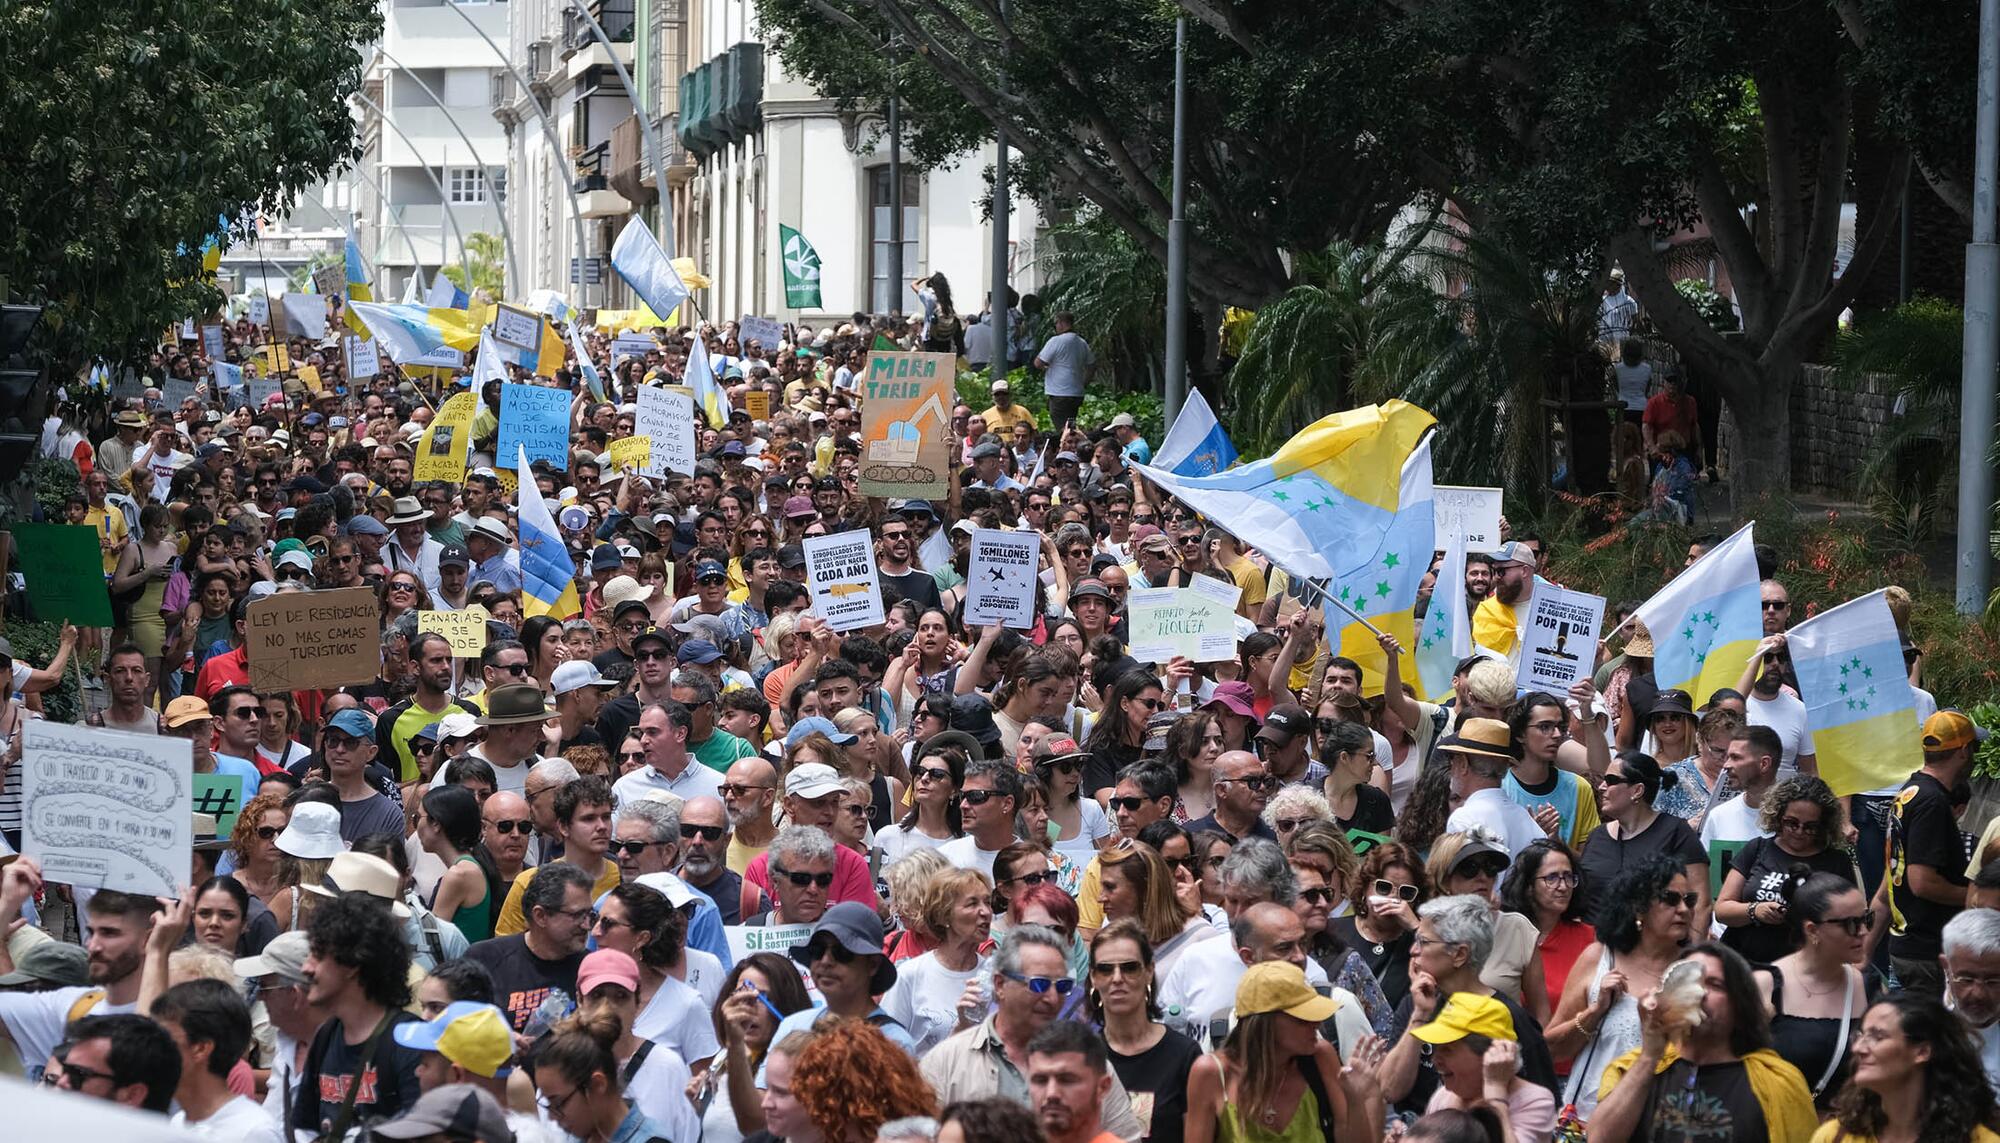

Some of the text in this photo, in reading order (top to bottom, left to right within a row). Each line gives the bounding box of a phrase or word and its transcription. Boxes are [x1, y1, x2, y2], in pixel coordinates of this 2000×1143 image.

[870, 356, 936, 380] MORA
[509, 388, 566, 402] NUEVO
[508, 401, 566, 412] MODELO
[521, 413, 544, 422] DE
[504, 423, 566, 434] TURISMO
[650, 428, 662, 437] NO
[650, 440, 683, 453] ENDE
[418, 460, 458, 469] SE ACABA
[432, 470, 458, 480] JUEGO
[812, 546, 852, 559] ATROPELLADOS
[848, 556, 867, 564] NACEN
[816, 563, 869, 582] CADA AÑO
[837, 601, 862, 609] OBJETIVO
[1549, 603, 1570, 613] MILLONES
[252, 604, 376, 627] LEY DE RESIDENCIA
[422, 613, 483, 624] CANARIAS
[1547, 609, 1567, 619] AGUAS
[1568, 614, 1592, 624] FECALES
[452, 626, 469, 636] SE
[1536, 615, 1590, 636] POR DÍA
[265, 627, 366, 648] NO MAS CAMAS
[1533, 667, 1575, 681] VERTER?
[1547, 663, 1576, 674] PODEMOS
[43, 763, 56, 777] UN
[62, 763, 98, 780] TRAYECTO
[105, 769, 114, 782] DE
[44, 812, 55, 827] SE
[98, 816, 109, 830] EN
[746, 930, 762, 949] SÍ
[776, 929, 811, 939] TURISMO
